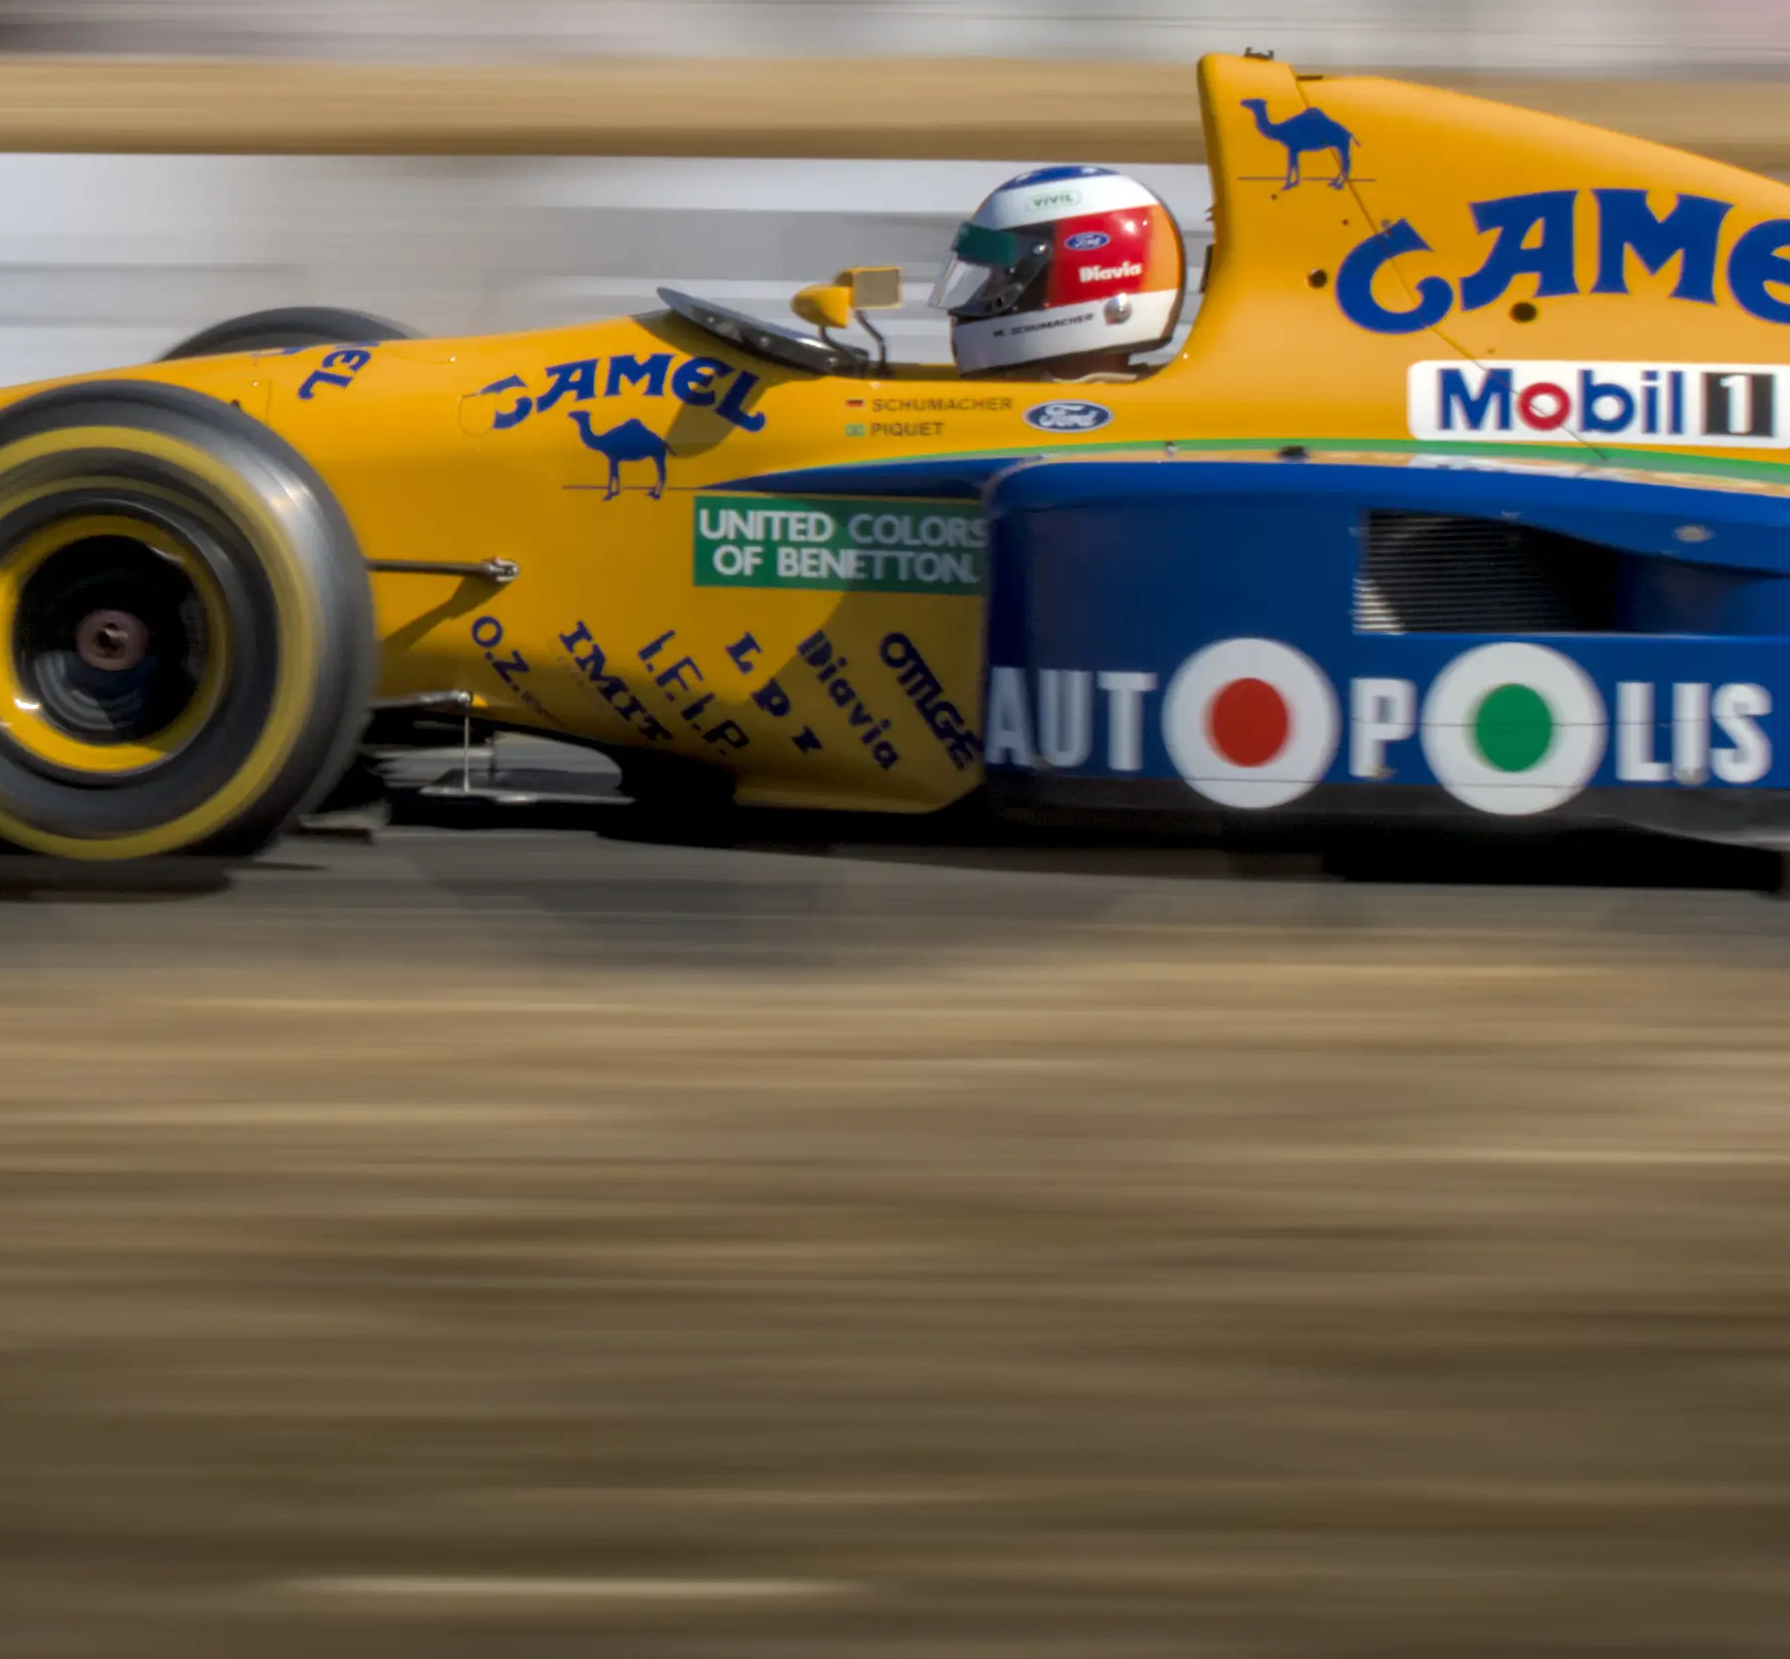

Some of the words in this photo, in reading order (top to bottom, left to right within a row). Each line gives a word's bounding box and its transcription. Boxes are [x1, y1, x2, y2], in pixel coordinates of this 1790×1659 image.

[1078, 260, 1143, 283] Diavia
[871, 397, 1013, 412] SCHUMACHER
[1038, 403, 1099, 428] Ford
[1436, 367, 1686, 437] Mobil
[1716, 373, 1762, 436] 1
[869, 421, 944, 437] PIQUET
[699, 508, 836, 542] UNITED
[847, 513, 989, 547] COLORS
[713, 545, 765, 576] OF
[796, 629, 900, 772] Diavia
